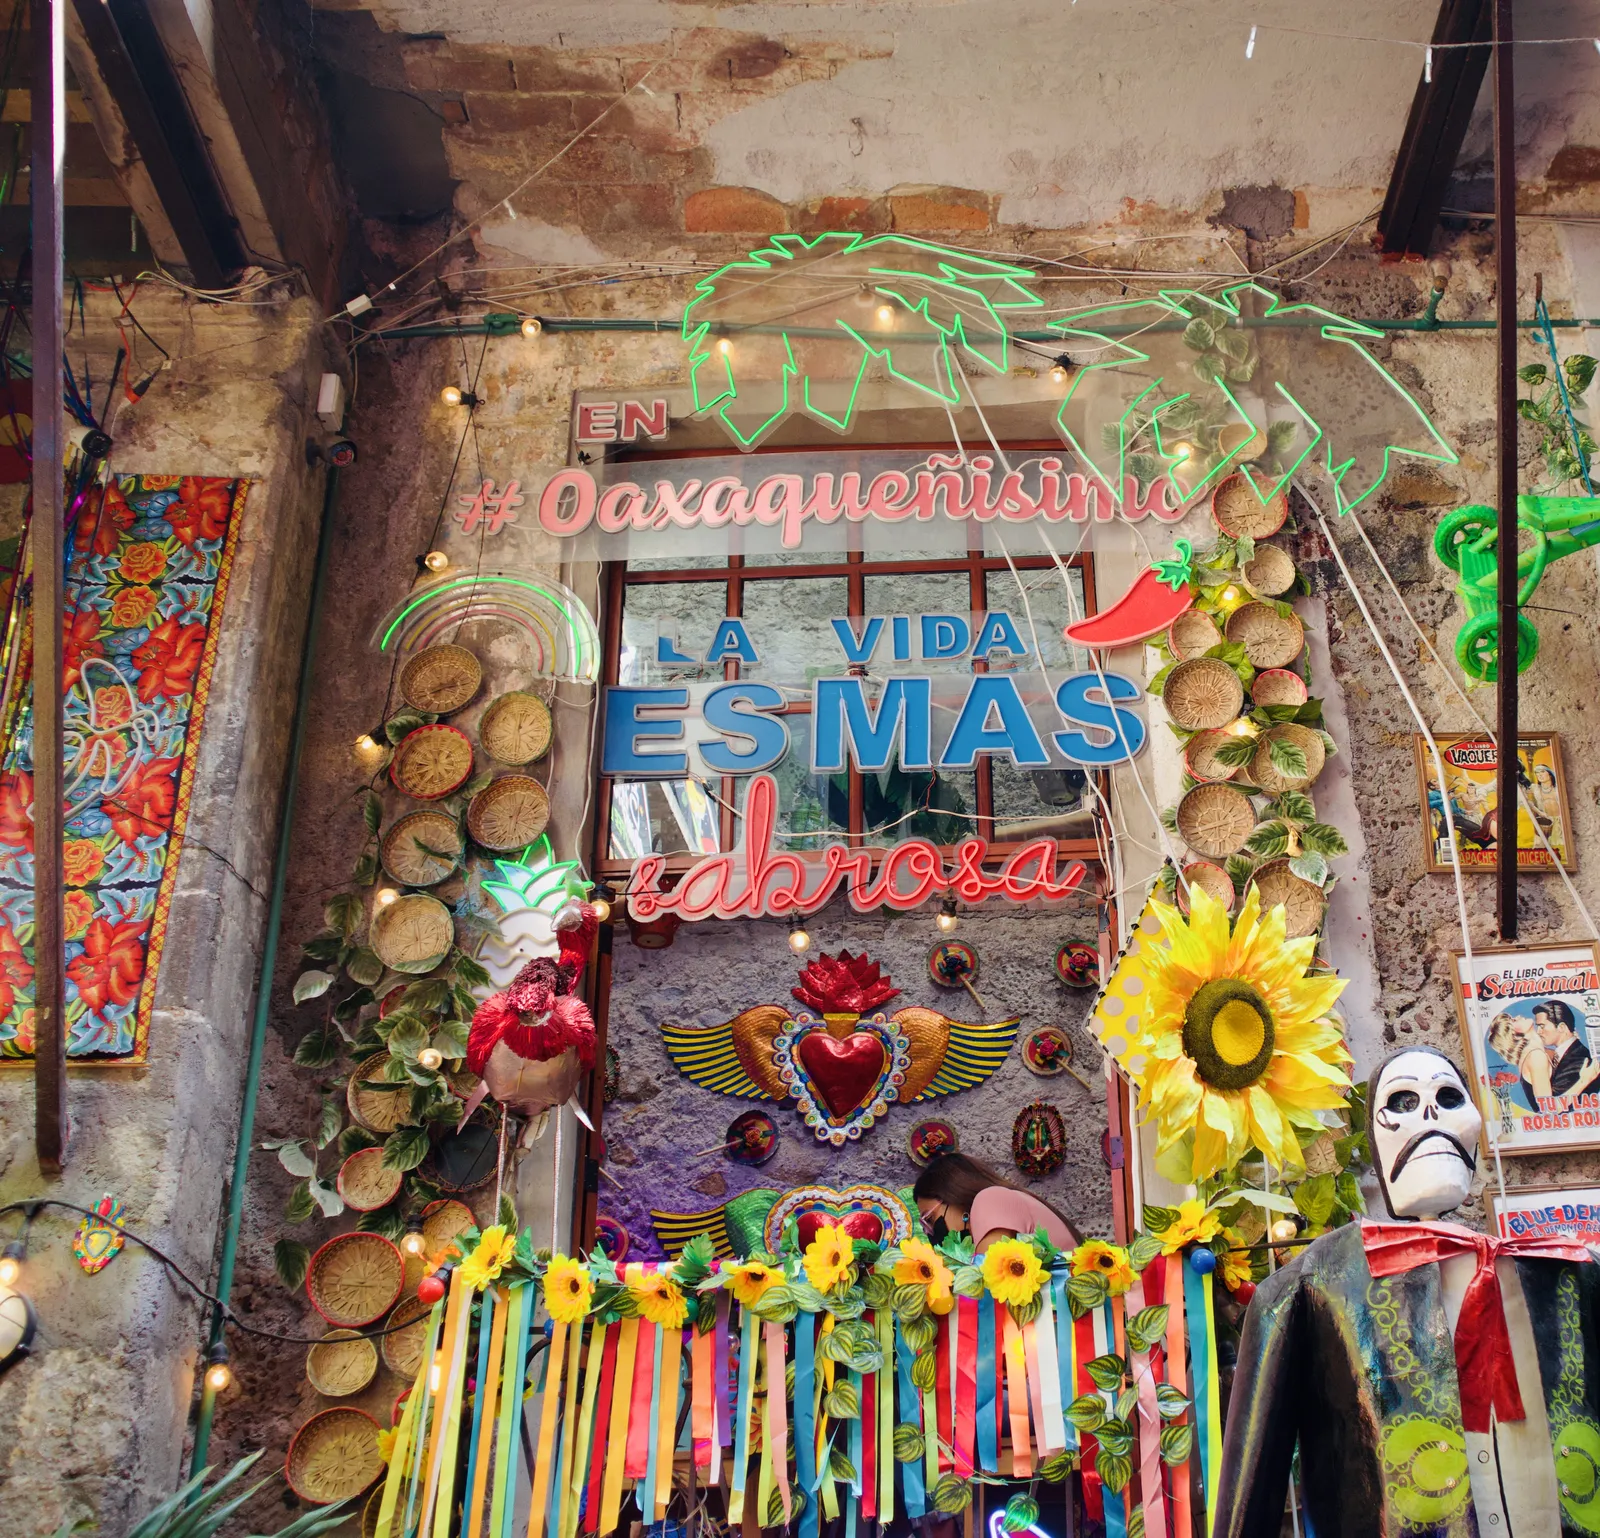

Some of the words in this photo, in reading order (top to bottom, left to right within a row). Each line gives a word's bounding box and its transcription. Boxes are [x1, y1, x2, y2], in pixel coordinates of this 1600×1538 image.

[575, 400, 669, 442] EN
[655, 615, 762, 667] LA
[829, 611, 1029, 665] VIDA
[600, 680, 791, 776] ES
[810, 672, 1150, 775] MAS
[1450, 749, 1498, 764] VAQUER
[628, 773, 1088, 922] sabrosa
[1478, 970, 1592, 1001] Semanal
[1503, 970, 1514, 979] EL
[1516, 968, 1544, 978] LIBRO
[1536, 1097, 1557, 1112] TU
[1559, 1095, 1569, 1111] Y
[1572, 1093, 1599, 1110] LAS
[1522, 1113, 1571, 1132] ROSAS
[1508, 1206, 1559, 1235] BLUE
